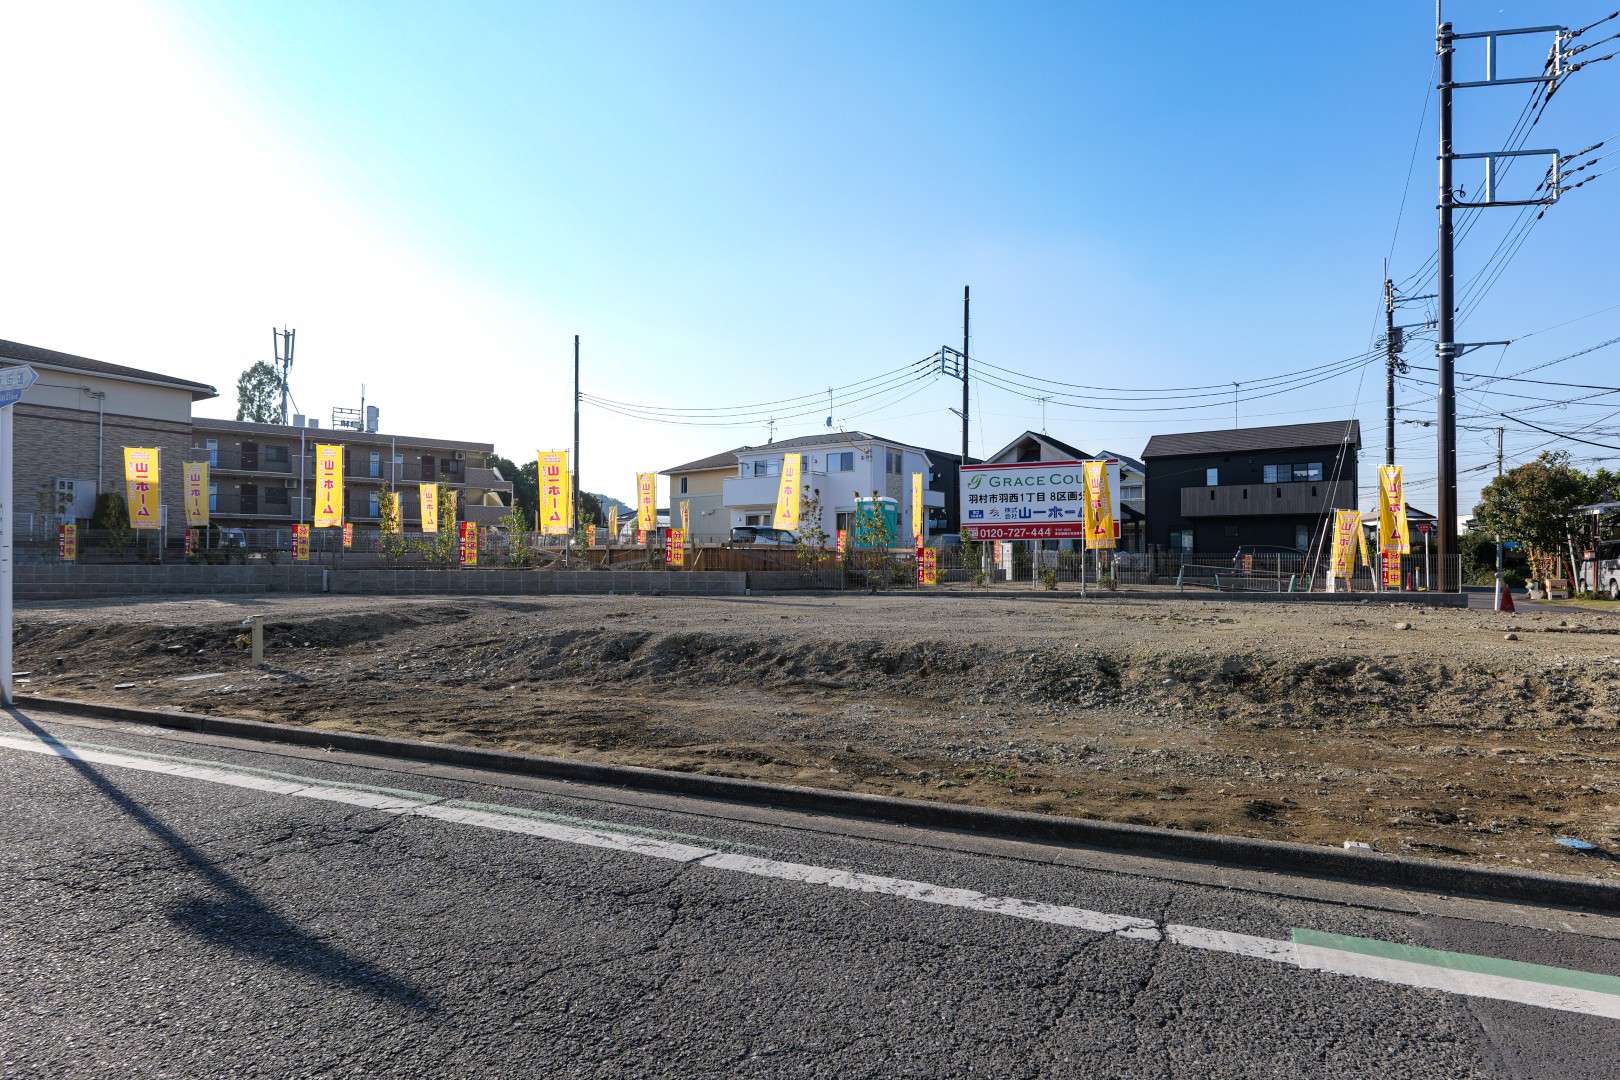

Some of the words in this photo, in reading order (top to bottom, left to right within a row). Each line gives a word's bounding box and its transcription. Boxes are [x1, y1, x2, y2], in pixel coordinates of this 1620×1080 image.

[989, 476, 1046, 488] GRACE
[1091, 477, 1106, 535] 山一ホーム
[1388, 482, 1402, 539] 山一ホーム
[980, 527, 1052, 538] 0120-727-444
[1336, 521, 1352, 567] 山一ホーム
